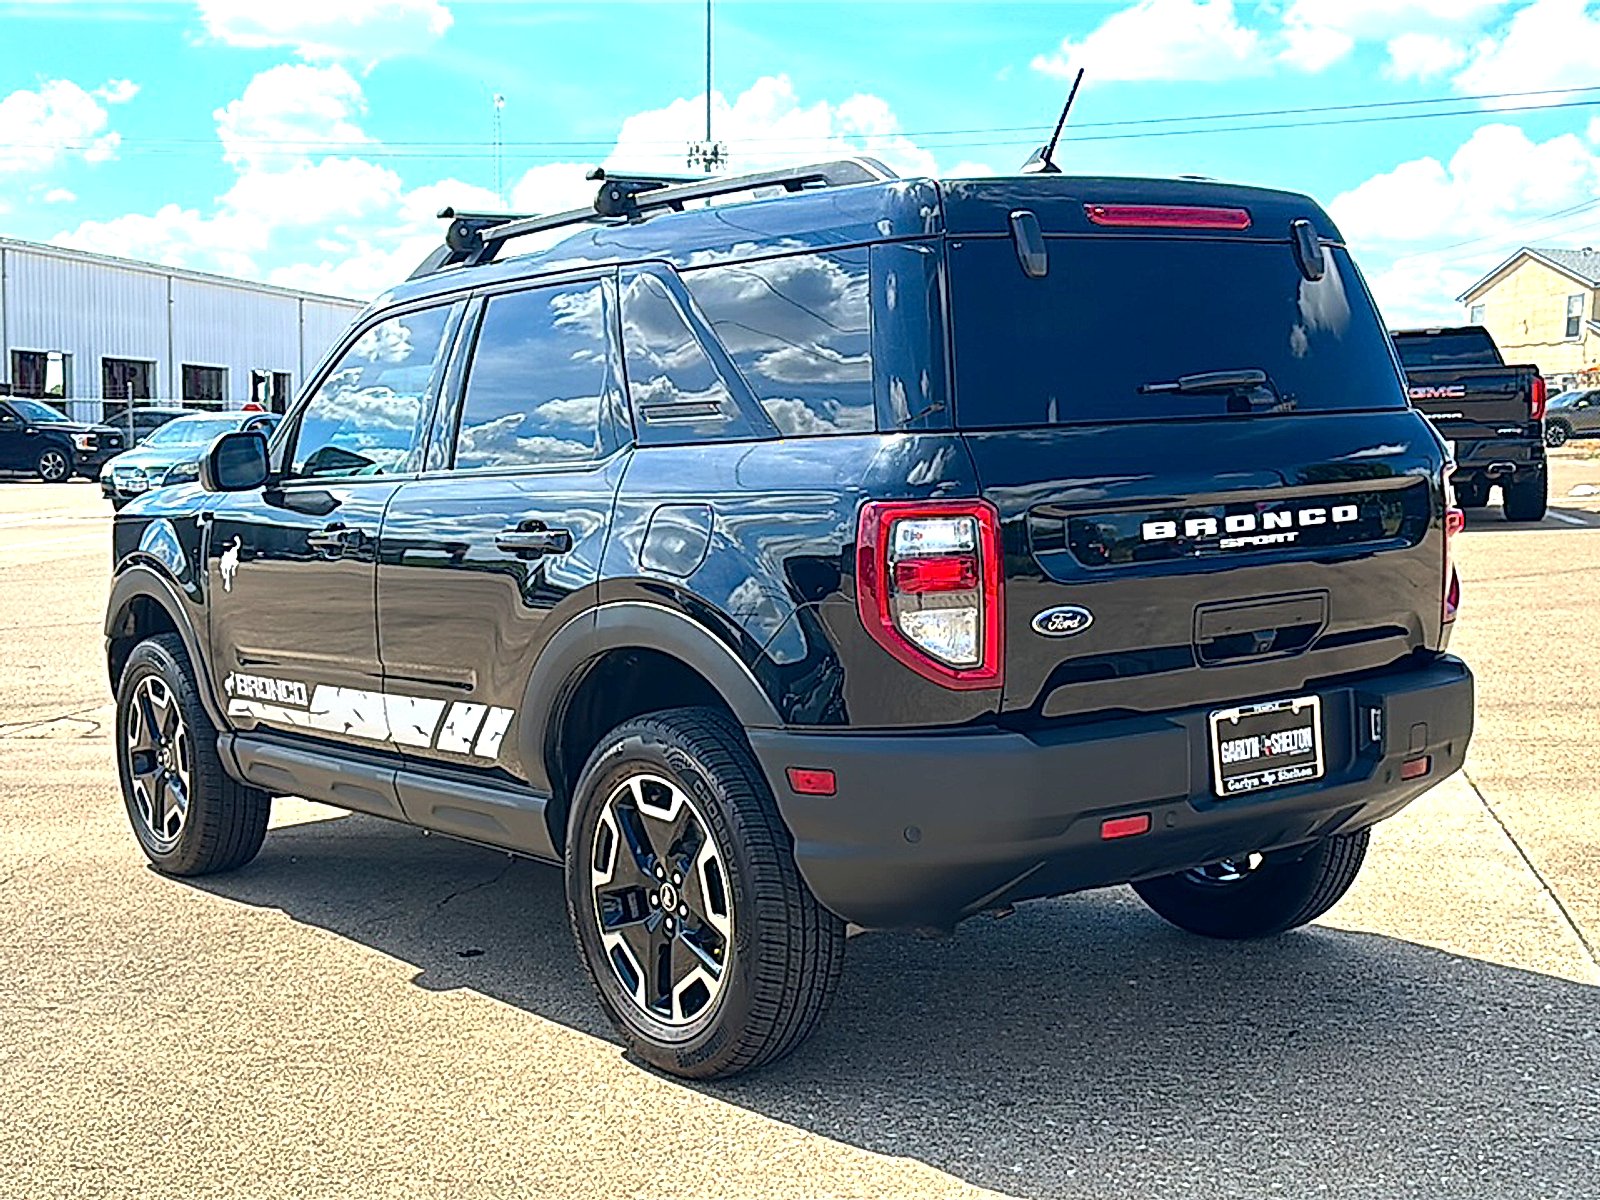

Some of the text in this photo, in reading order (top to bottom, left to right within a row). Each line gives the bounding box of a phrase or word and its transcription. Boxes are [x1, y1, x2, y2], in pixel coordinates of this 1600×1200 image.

[1408, 385, 1466, 399] GMC
[1142, 504, 1359, 541] BRONCO
[1219, 531, 1300, 549] SPORT
[1047, 612, 1082, 631] Ford
[234, 673, 309, 707] BRONCO
[1270, 726, 1314, 756] SHELTON
